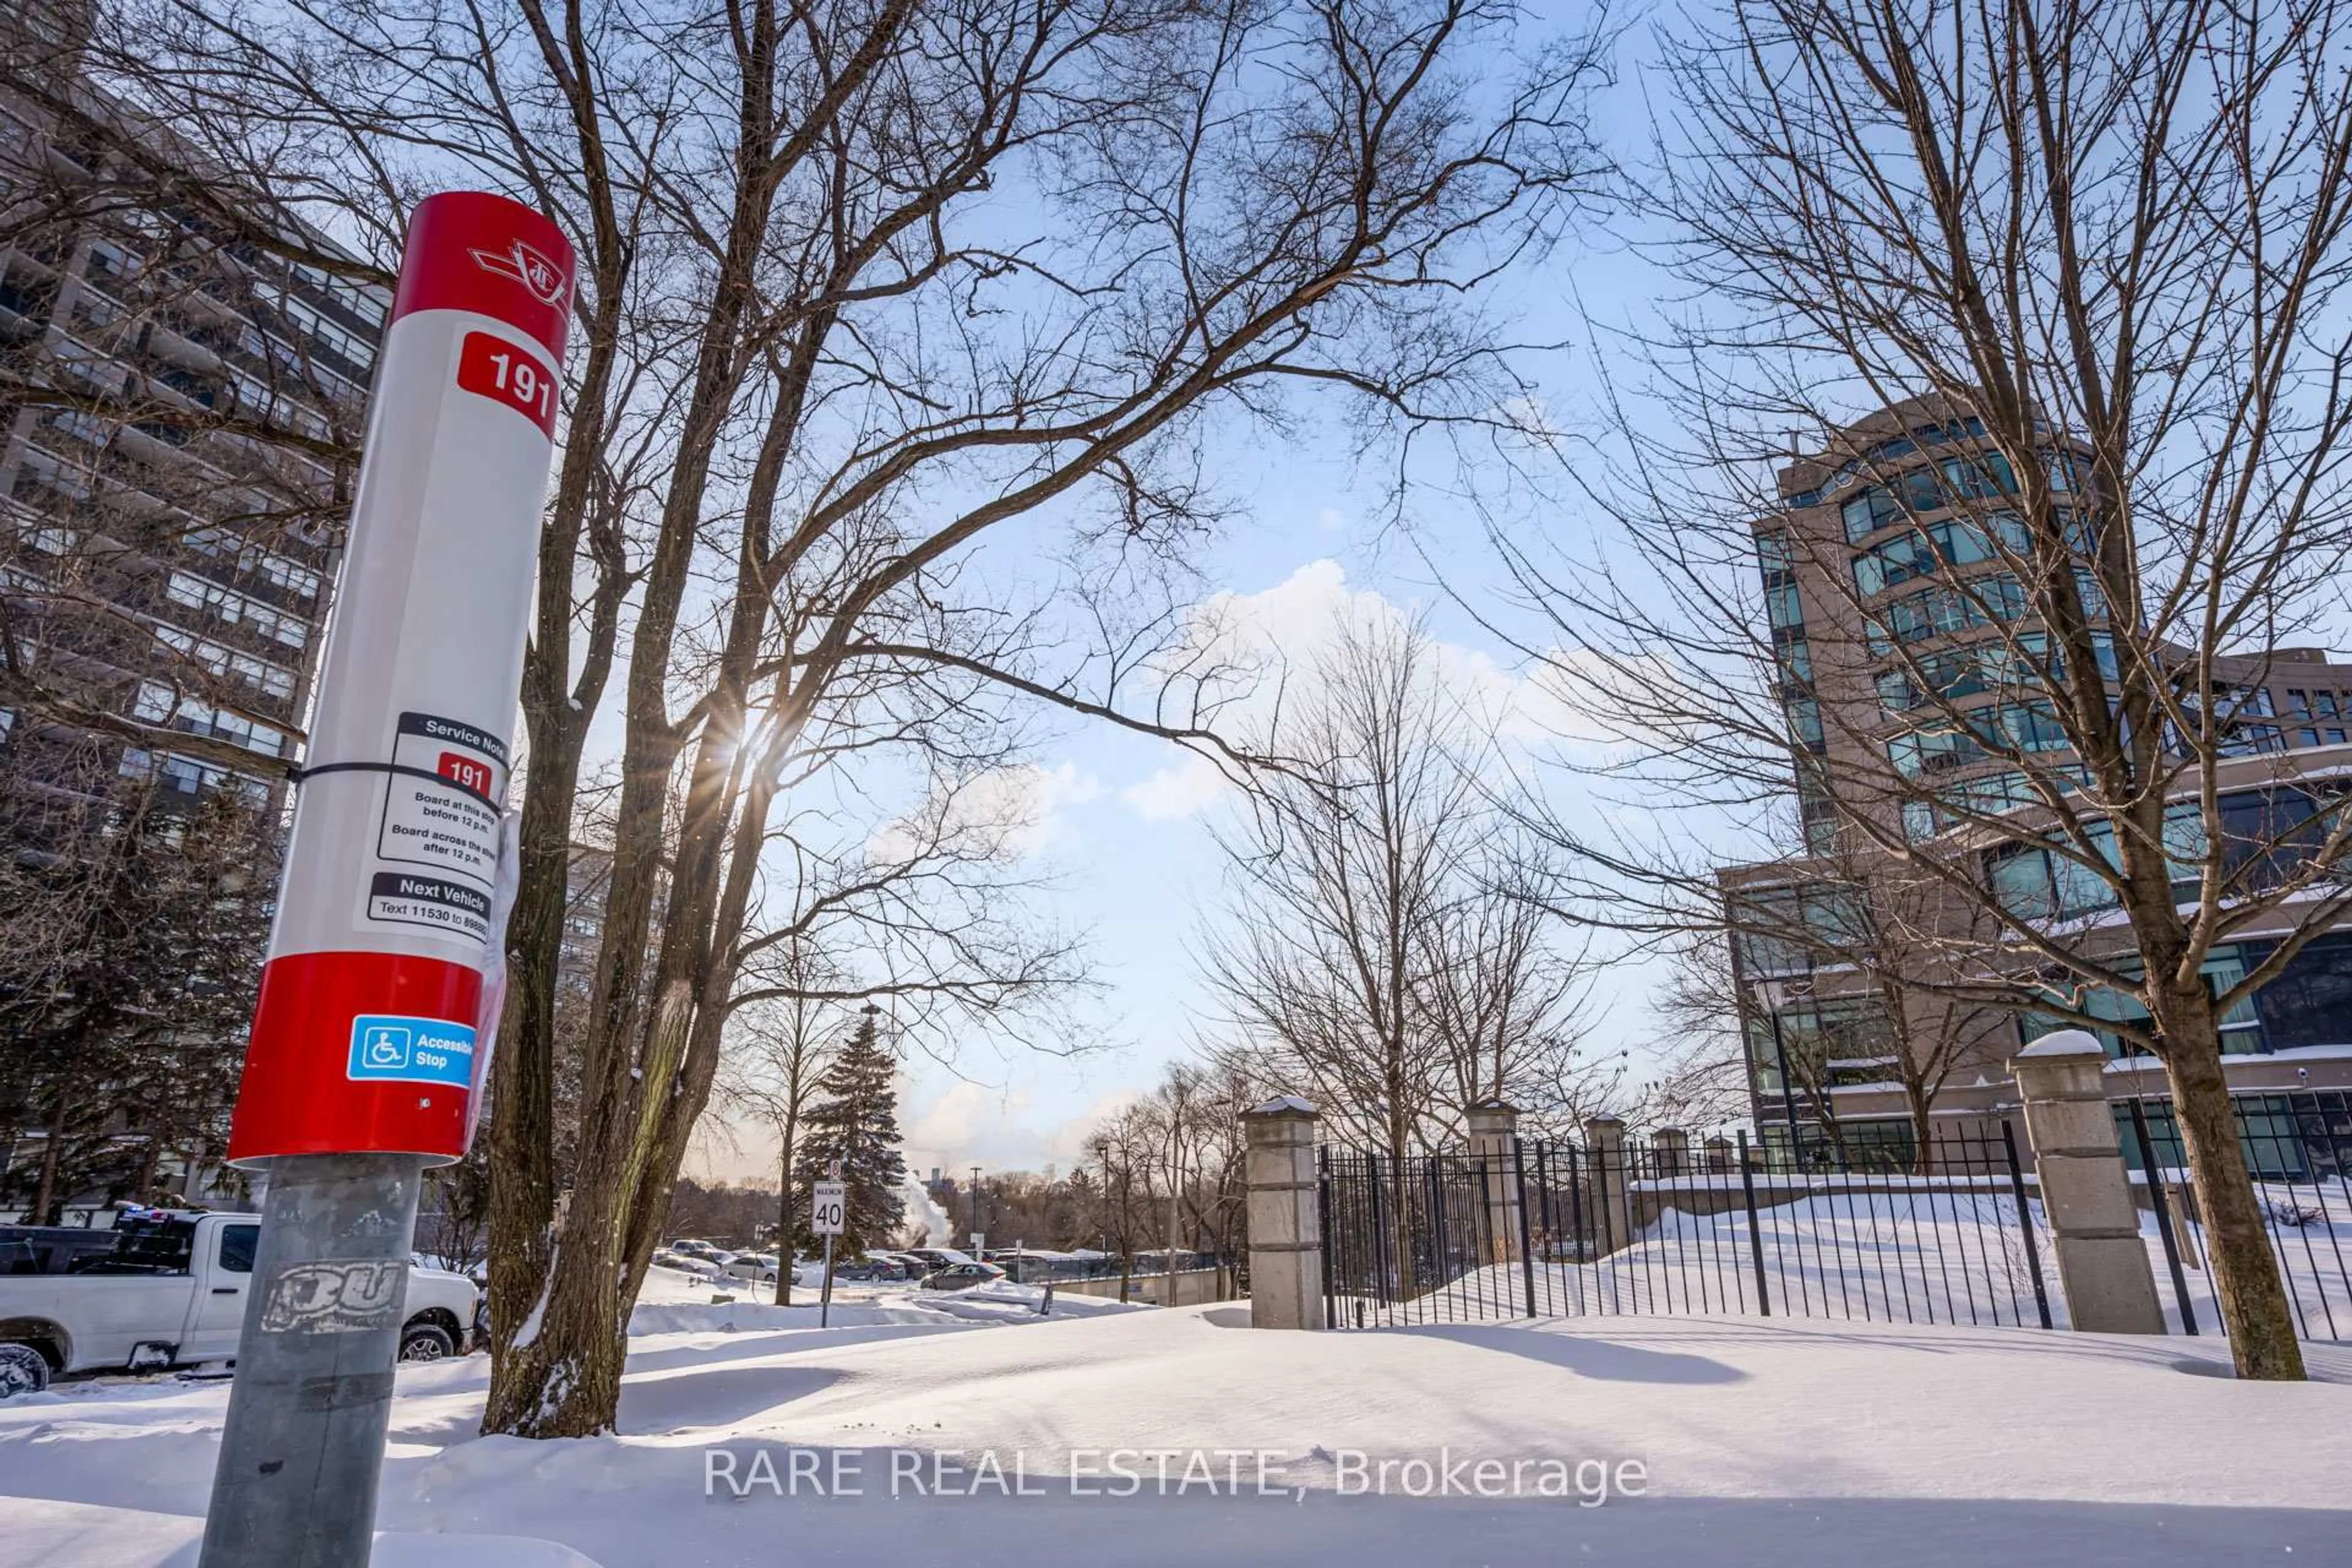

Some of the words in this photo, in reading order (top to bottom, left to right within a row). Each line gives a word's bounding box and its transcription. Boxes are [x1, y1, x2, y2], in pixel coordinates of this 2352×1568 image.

[490, 353, 551, 418] 191
[426, 720, 481, 745] Service
[450, 761, 483, 790] 191
[415, 792, 450, 807] Board
[452, 801, 462, 810] at
[464, 804, 480, 817] this
[423, 806, 459, 822] before
[461, 816, 472, 827] 12
[392, 824, 429, 838] Board
[432, 832, 467, 846] across
[469, 840, 481, 852] the
[423, 843, 449, 855] after
[453, 848, 464, 859] 12
[400, 879, 440, 900] Next
[444, 886, 485, 912] Vehicle
[380, 902, 407, 914] Text
[412, 906, 450, 921] 11530
[452, 913, 462, 924] to
[416, 1051, 448, 1070] Stop
[815, 1204, 842, 1226] 40
